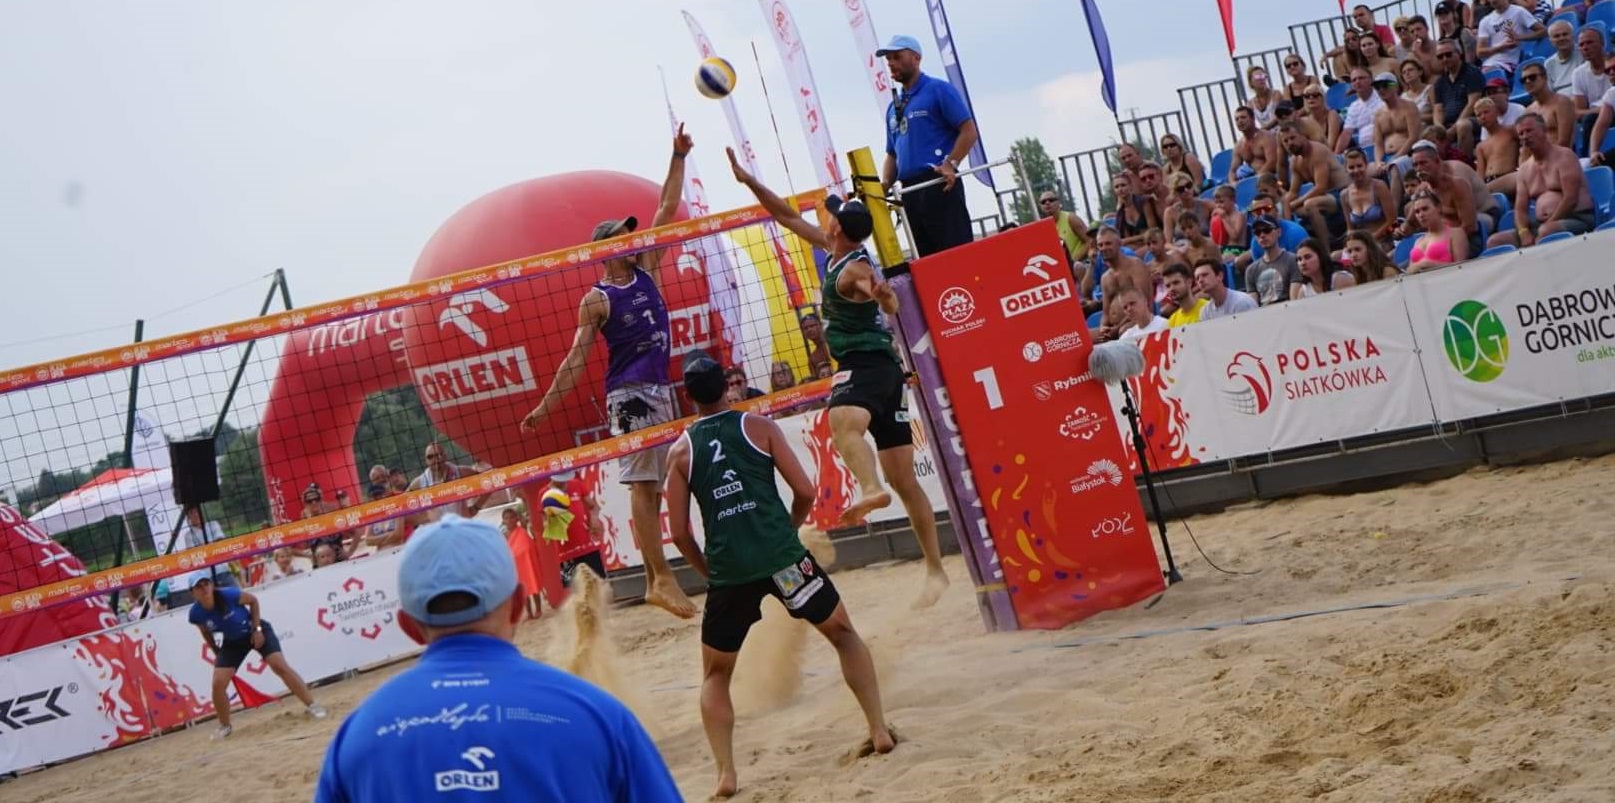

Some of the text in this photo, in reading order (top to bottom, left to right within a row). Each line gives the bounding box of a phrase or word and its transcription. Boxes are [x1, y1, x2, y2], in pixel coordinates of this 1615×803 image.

[1006, 283, 1066, 312] ORLEN
[642, 309, 656, 325] 1
[1525, 314, 1615, 354] GÓRNIC
[1276, 336, 1381, 375] POLSKA
[421, 354, 524, 402] ORLEN
[973, 366, 1004, 410] 1
[1285, 365, 1388, 401] SIATKÓWKA
[708, 438, 727, 463] 2
[715, 482, 741, 497] ORLEN
[717, 500, 757, 521] martes
[440, 773, 494, 788] ORLEN
